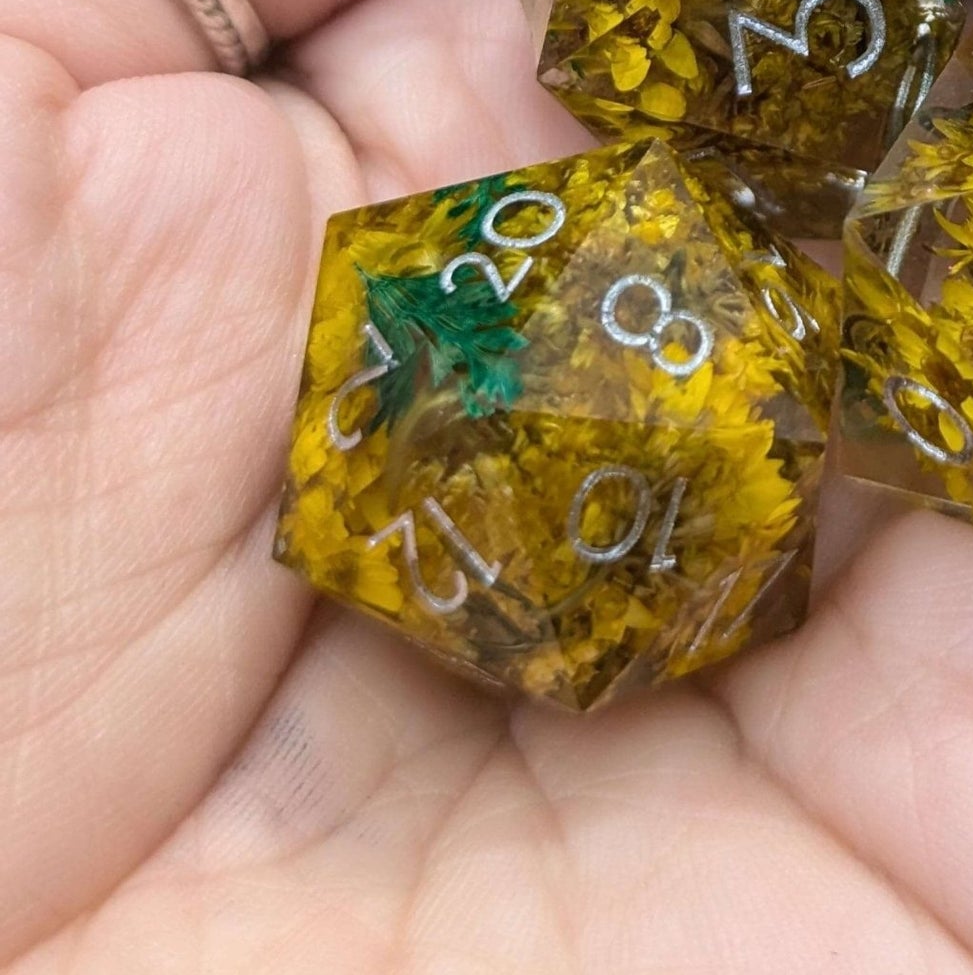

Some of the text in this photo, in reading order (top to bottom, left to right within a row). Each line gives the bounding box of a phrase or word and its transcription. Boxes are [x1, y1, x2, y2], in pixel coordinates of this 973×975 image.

[439, 189, 567, 302] 20
[601, 273, 713, 377] 8
[366, 495, 502, 615] 12
[567, 463, 690, 574] 10
